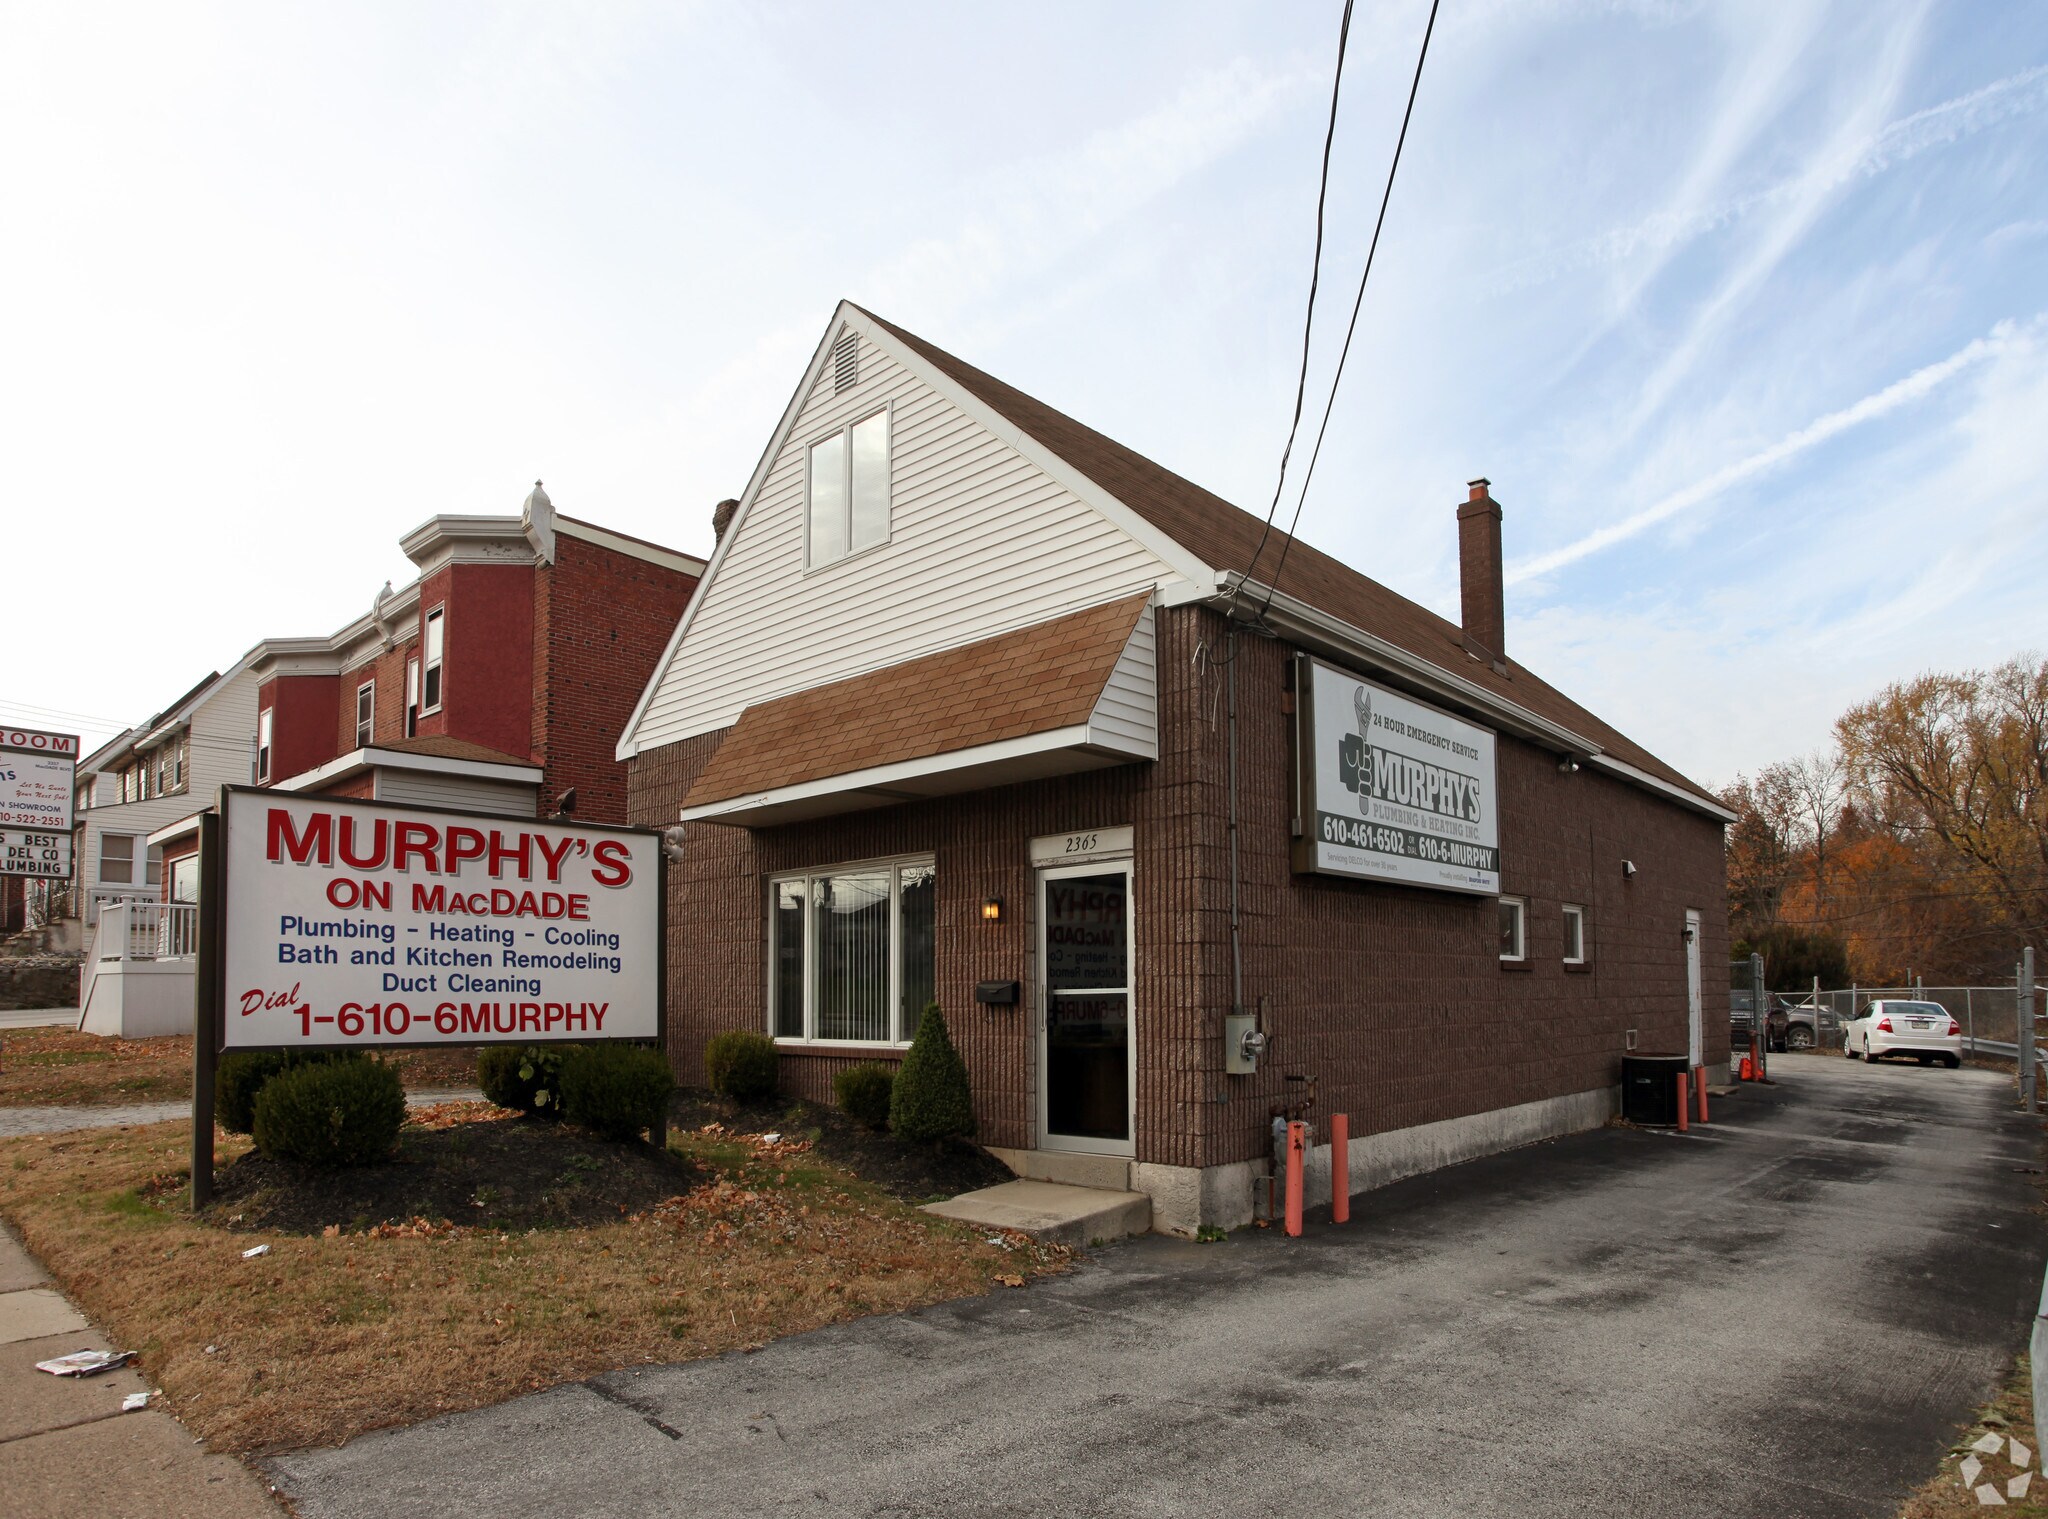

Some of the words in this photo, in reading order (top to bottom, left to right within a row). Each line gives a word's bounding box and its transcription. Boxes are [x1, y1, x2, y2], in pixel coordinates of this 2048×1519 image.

[1373, 713, 1382, 727] 24
[1384, 717, 1405, 735] HOUR
[1407, 722, 1451, 750] EMERGENCY
[1452, 742, 1479, 760] SERVICE
[9, 801, 62, 813] SHOWROOM
[1373, 803, 1419, 827] PLUMBING
[1420, 816, 1427, 828] &
[1429, 818, 1463, 837] HEATING
[1465, 827, 1481, 841] INC.
[8, 846, 34, 859] DEL
[25, 834, 59, 847] BEST
[266, 808, 633, 888] MURPHY'S
[1066, 833, 1097, 853] 2365
[1323, 816, 1405, 854] 610-461-6502
[1419, 836, 1492, 869] 610-6-MURPHY
[1408, 835, 1415, 844] OR
[326, 877, 393, 911] ON
[279, 915, 396, 943] Plumbing
[429, 922, 516, 947] Heating
[544, 927, 621, 950] Cooling
[278, 943, 339, 965] Bath
[350, 946, 396, 966] and
[407, 947, 493, 968] Kitchen
[502, 951, 622, 973] Remodeling
[382, 973, 437, 993] Duct
[447, 974, 542, 996] Cleaning
[240, 981, 301, 1018] Dial
[293, 1002, 610, 1037] 1-610-6MURPHY
